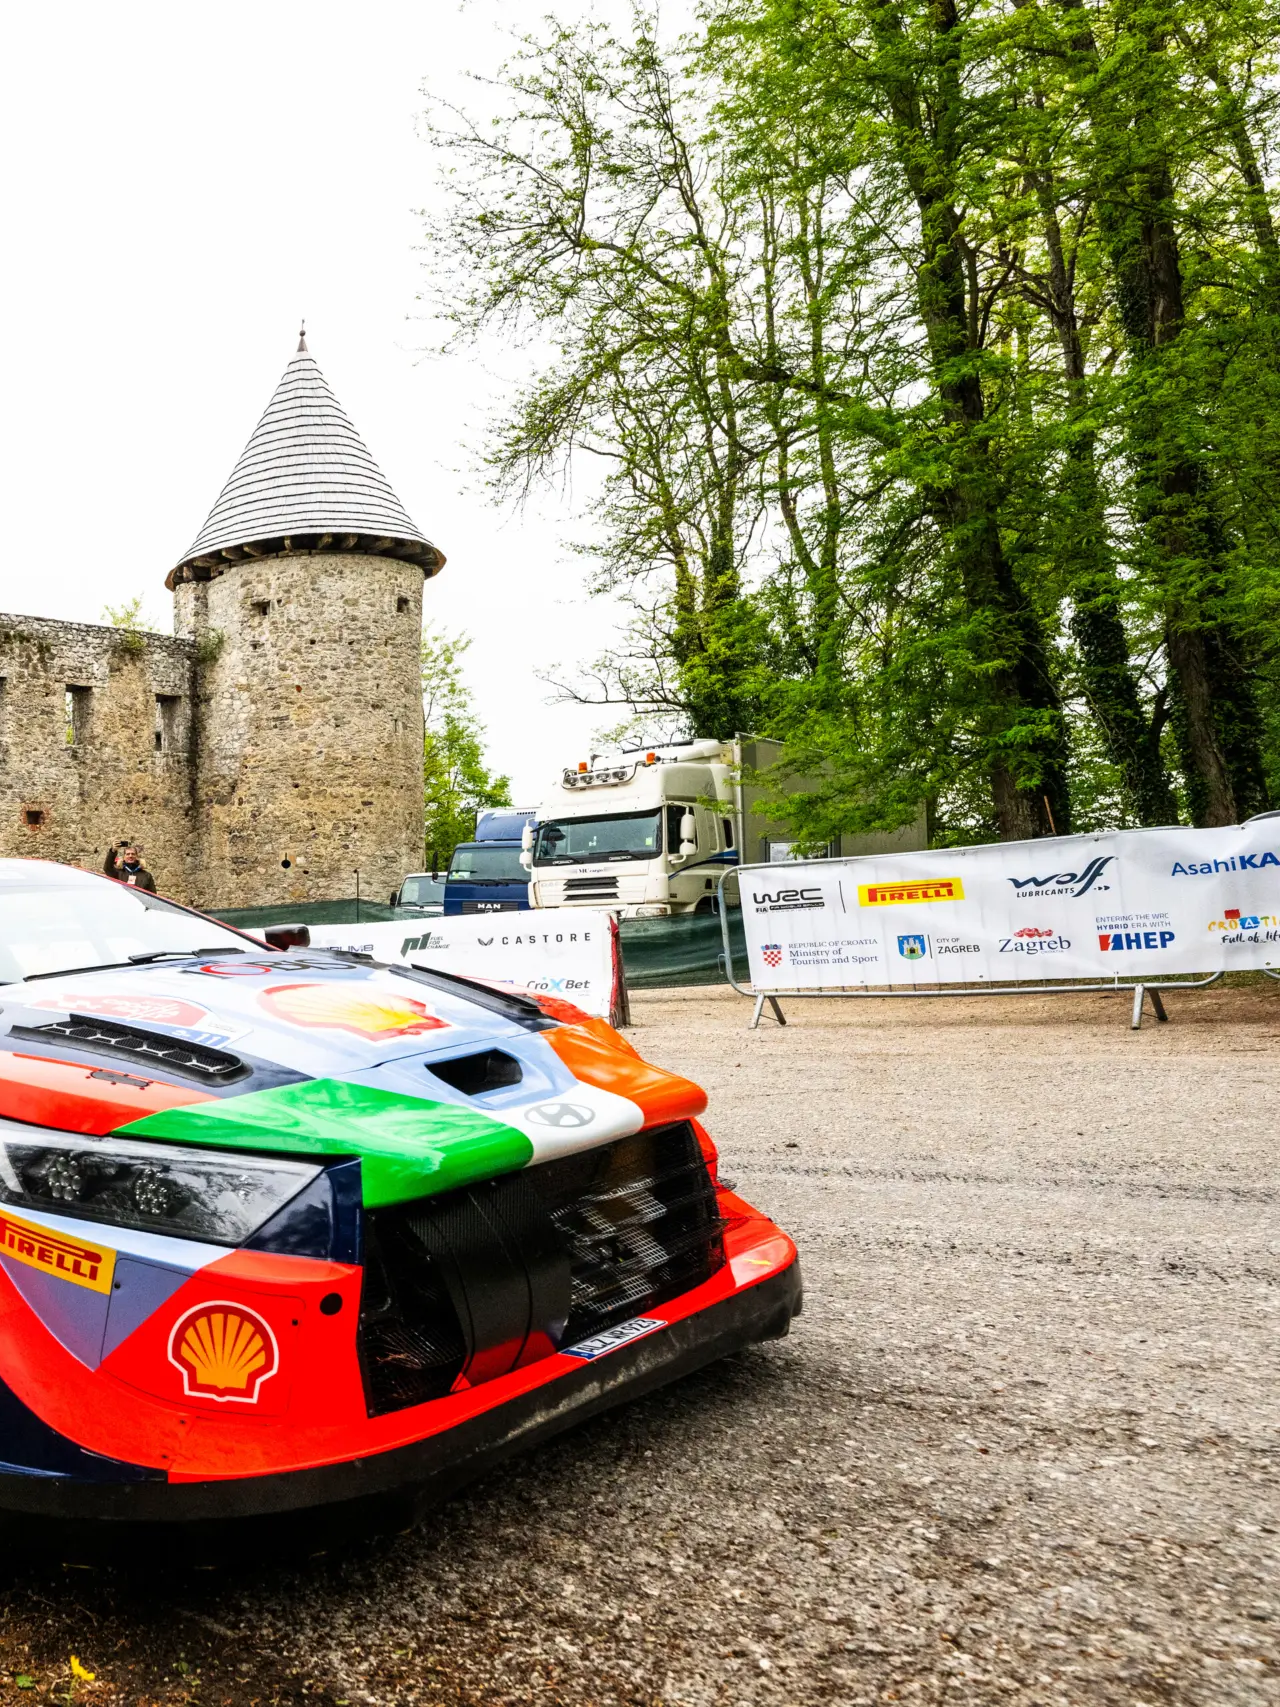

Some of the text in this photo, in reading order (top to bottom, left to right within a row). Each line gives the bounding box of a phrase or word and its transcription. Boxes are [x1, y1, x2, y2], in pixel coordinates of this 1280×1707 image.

[753, 888, 824, 904] WRC
[867, 882, 954, 903] PIRELLI
[1016, 886, 1076, 898] LUBRICANTS
[1095, 912, 1169, 923] ENTERING THE WRC
[1208, 916, 1280, 931] CROATI
[1096, 923, 1129, 931] HYBRID
[1149, 920, 1171, 928] WITH
[501, 932, 592, 946] CASTORE
[1124, 931, 1176, 950] HEP
[1265, 930, 1280, 942] lif
[788, 940, 828, 949] REPUBLIC
[840, 938, 879, 946] CROATIA
[937, 944, 981, 954] ZAGREB
[998, 935, 1072, 955] Zagreb
[789, 948, 830, 958] Ministry
[790, 954, 879, 966] Tourism and Sport
[526, 977, 591, 992] CroXBet
